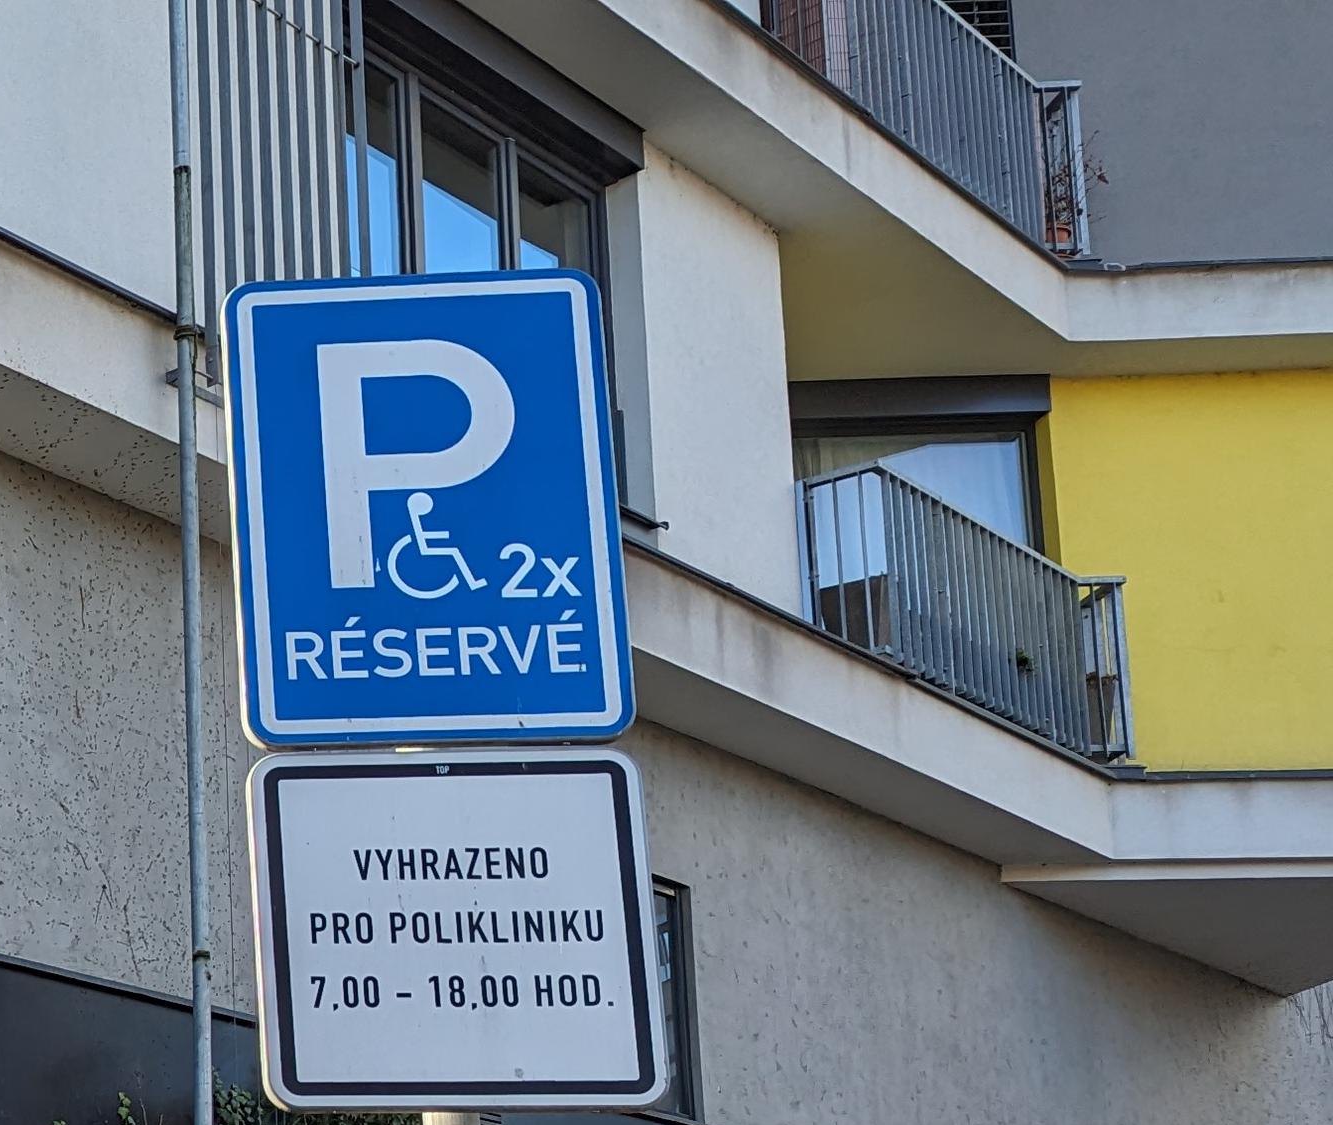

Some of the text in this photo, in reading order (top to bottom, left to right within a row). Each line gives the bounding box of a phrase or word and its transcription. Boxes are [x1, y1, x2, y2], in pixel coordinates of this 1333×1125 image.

[317, 339, 515, 589] P
[498, 543, 582, 598] 2x
[285, 609, 587, 680] RÉSERVÉ
[353, 847, 549, 881] VYHRAZENO
[310, 909, 604, 944] PRO POLIKLINIKU
[534, 974, 615, 1007] HOD.
